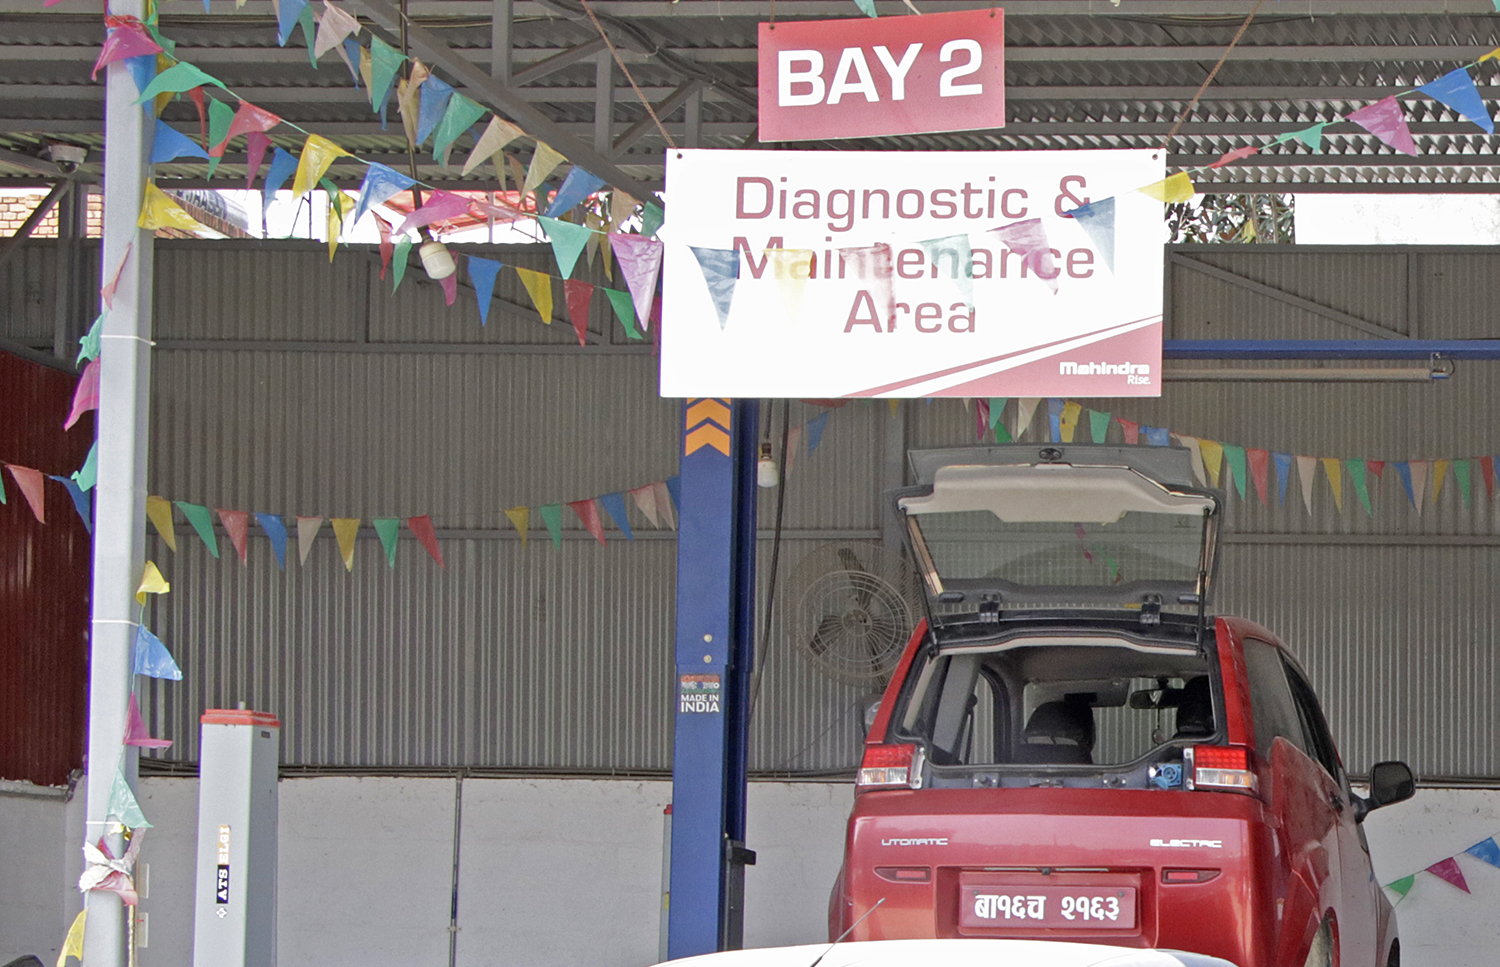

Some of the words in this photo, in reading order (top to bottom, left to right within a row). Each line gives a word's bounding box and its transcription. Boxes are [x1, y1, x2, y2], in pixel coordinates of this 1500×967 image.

[777, 42, 923, 107] BAY
[938, 39, 984, 98] 2
[735, 176, 1029, 232] Diagnostic
[1053, 175, 1091, 219] &
[843, 289, 976, 333] Area
[1059, 361, 1150, 375] Mahindra
[681, 694, 707, 702] MADE
[709, 694, 719, 702] IN
[681, 701, 720, 713] INDIA
[219, 827, 230, 864] ELGI
[1149, 838, 1223, 848] ELECTRIC
[218, 869, 228, 900] ATS
[1060, 896, 1120, 921] २१६३
